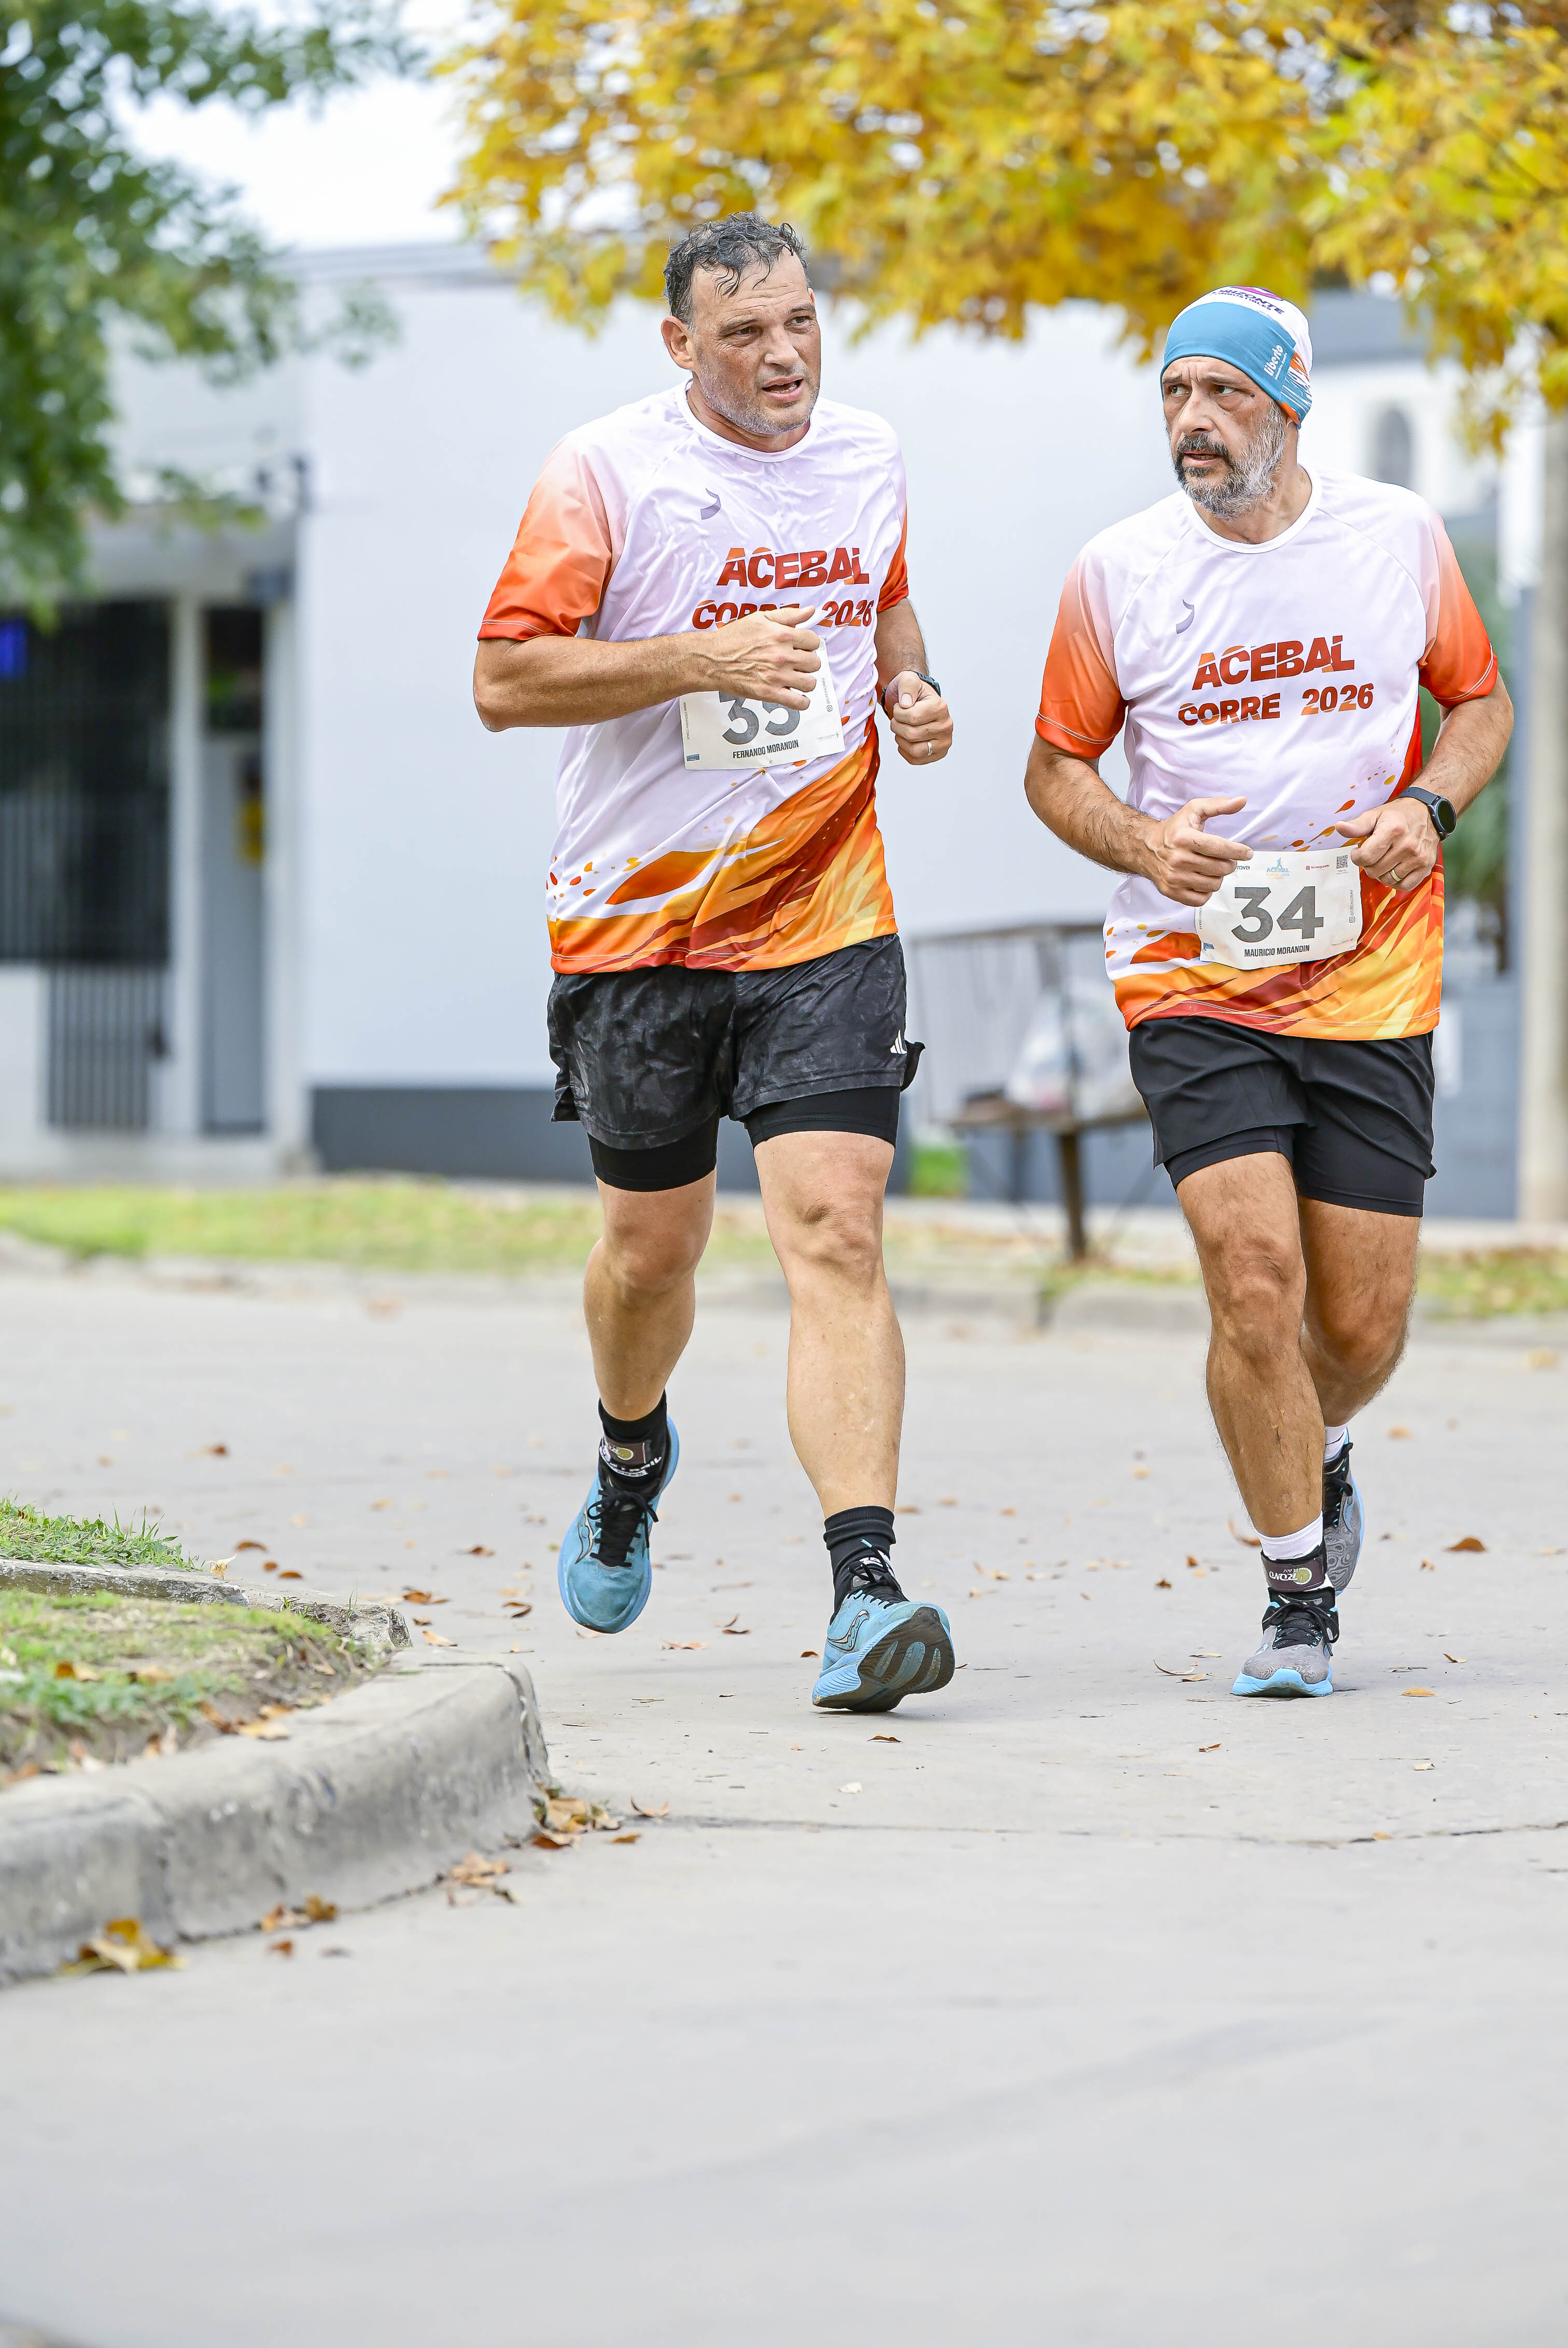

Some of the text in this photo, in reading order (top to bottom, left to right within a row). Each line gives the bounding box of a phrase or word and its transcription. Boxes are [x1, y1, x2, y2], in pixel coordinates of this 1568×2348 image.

[716, 547, 870, 589] ACEBAL
[817, 599, 874, 628] 2026
[1192, 635, 1355, 691] ACEBAL
[719, 690, 800, 745] 35
[1178, 683, 1374, 726] CORRE 2026
[733, 739, 799, 759] FERNANDO MORANDIN
[1231, 886, 1324, 943] 34
[1244, 945, 1310, 957] MAURICIO MORANDIN
